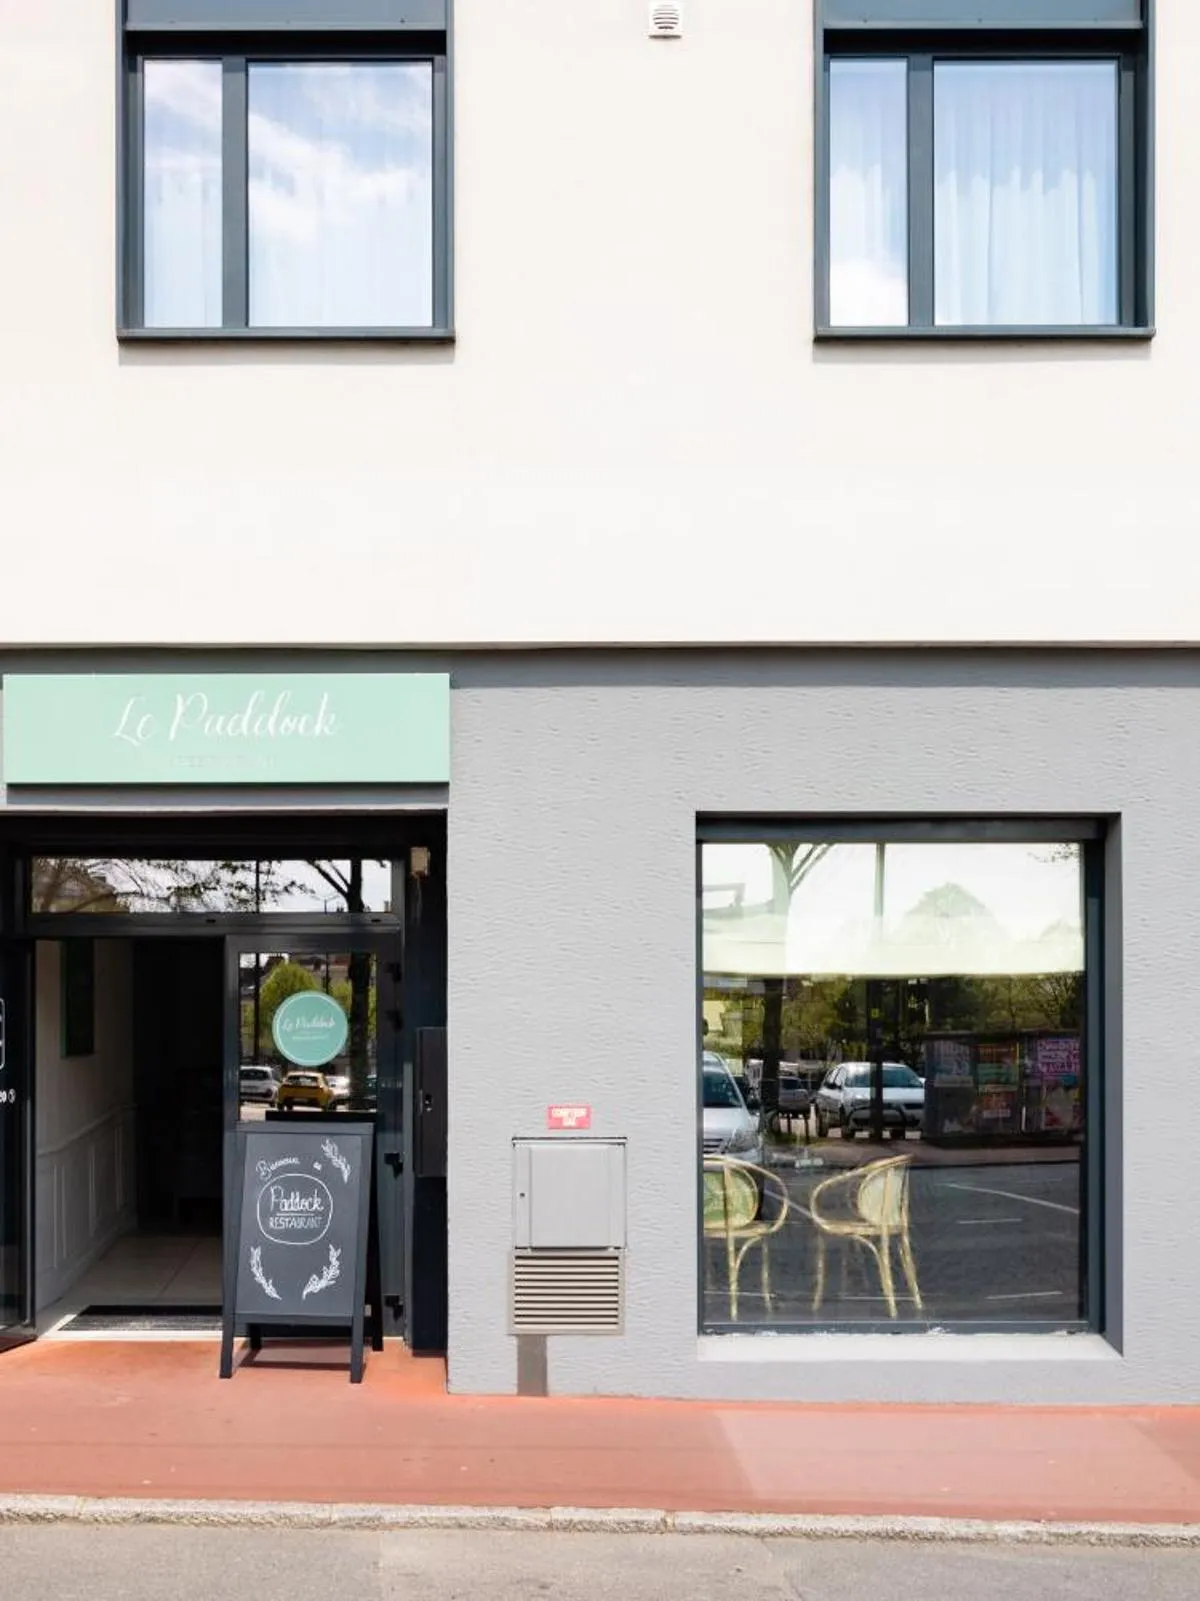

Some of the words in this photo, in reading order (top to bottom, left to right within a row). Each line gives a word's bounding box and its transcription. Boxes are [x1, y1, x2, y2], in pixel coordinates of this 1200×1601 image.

[112, 694, 156, 746] Le
[168, 690, 343, 741] Paddock
[270, 1185, 325, 1212] Paddock
[269, 1216, 322, 1229] RESTAURANT
